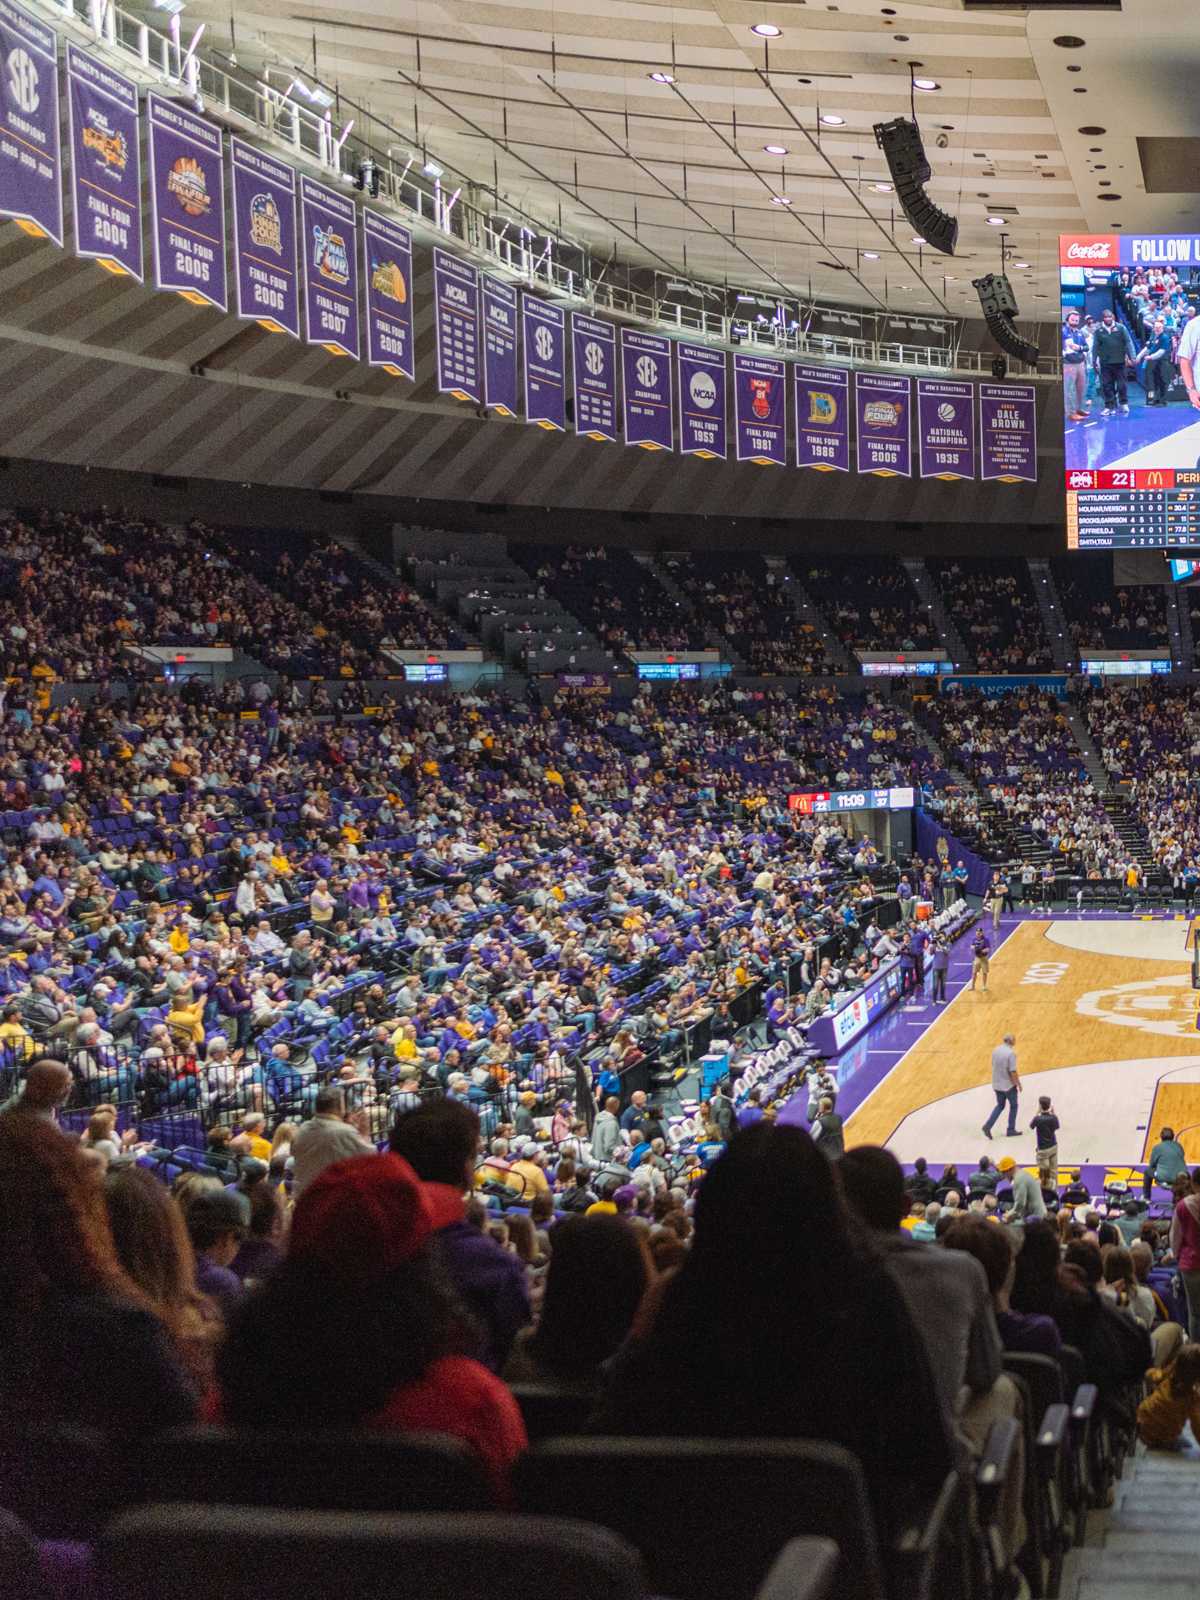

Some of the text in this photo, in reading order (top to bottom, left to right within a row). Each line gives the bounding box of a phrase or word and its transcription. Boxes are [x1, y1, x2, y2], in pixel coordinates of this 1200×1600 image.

[8, 48, 39, 113] SEC
[88, 195, 131, 227] FINAL FOUR
[94, 216, 128, 249] 2004
[169, 233, 213, 262] FINAL FOUR
[1132, 239, 1191, 262] FOLLOW
[175, 252, 210, 281] 2005
[248, 266, 288, 293] FINAL FOUR
[253, 283, 284, 311] 2006
[444, 283, 468, 305] NCAA
[316, 294, 350, 318] FINAL FOUR
[489, 304, 508, 325] NCAA
[321, 310, 346, 335] 2007
[376, 319, 406, 340] FINAL FOUR
[585, 341, 604, 376] SEC
[636, 355, 658, 388] SEC
[752, 380, 768, 388] NCAA
[940, 386, 966, 394] BASKETBALL
[693, 387, 716, 400] NCAA
[997, 410, 1020, 420] DALE
[689, 419, 719, 432] FINAL FOUR
[991, 418, 1026, 429] BROWN
[694, 429, 714, 444] 1953
[746, 427, 777, 440] FINAL FOUR
[930, 427, 964, 438] NATIONAL
[752, 437, 772, 451] 1981
[807, 435, 840, 447] FINAL FOUR
[868, 442, 901, 453] FINAL FOUR
[926, 436, 968, 445] CHAMPIONS
[871, 451, 897, 463] 2006
[936, 452, 959, 465] 1935
[1112, 473, 1128, 485] 22
[815, 797, 887, 811] 22 37
[836, 794, 866, 808] 11:09
[1019, 961, 1070, 985] COX
